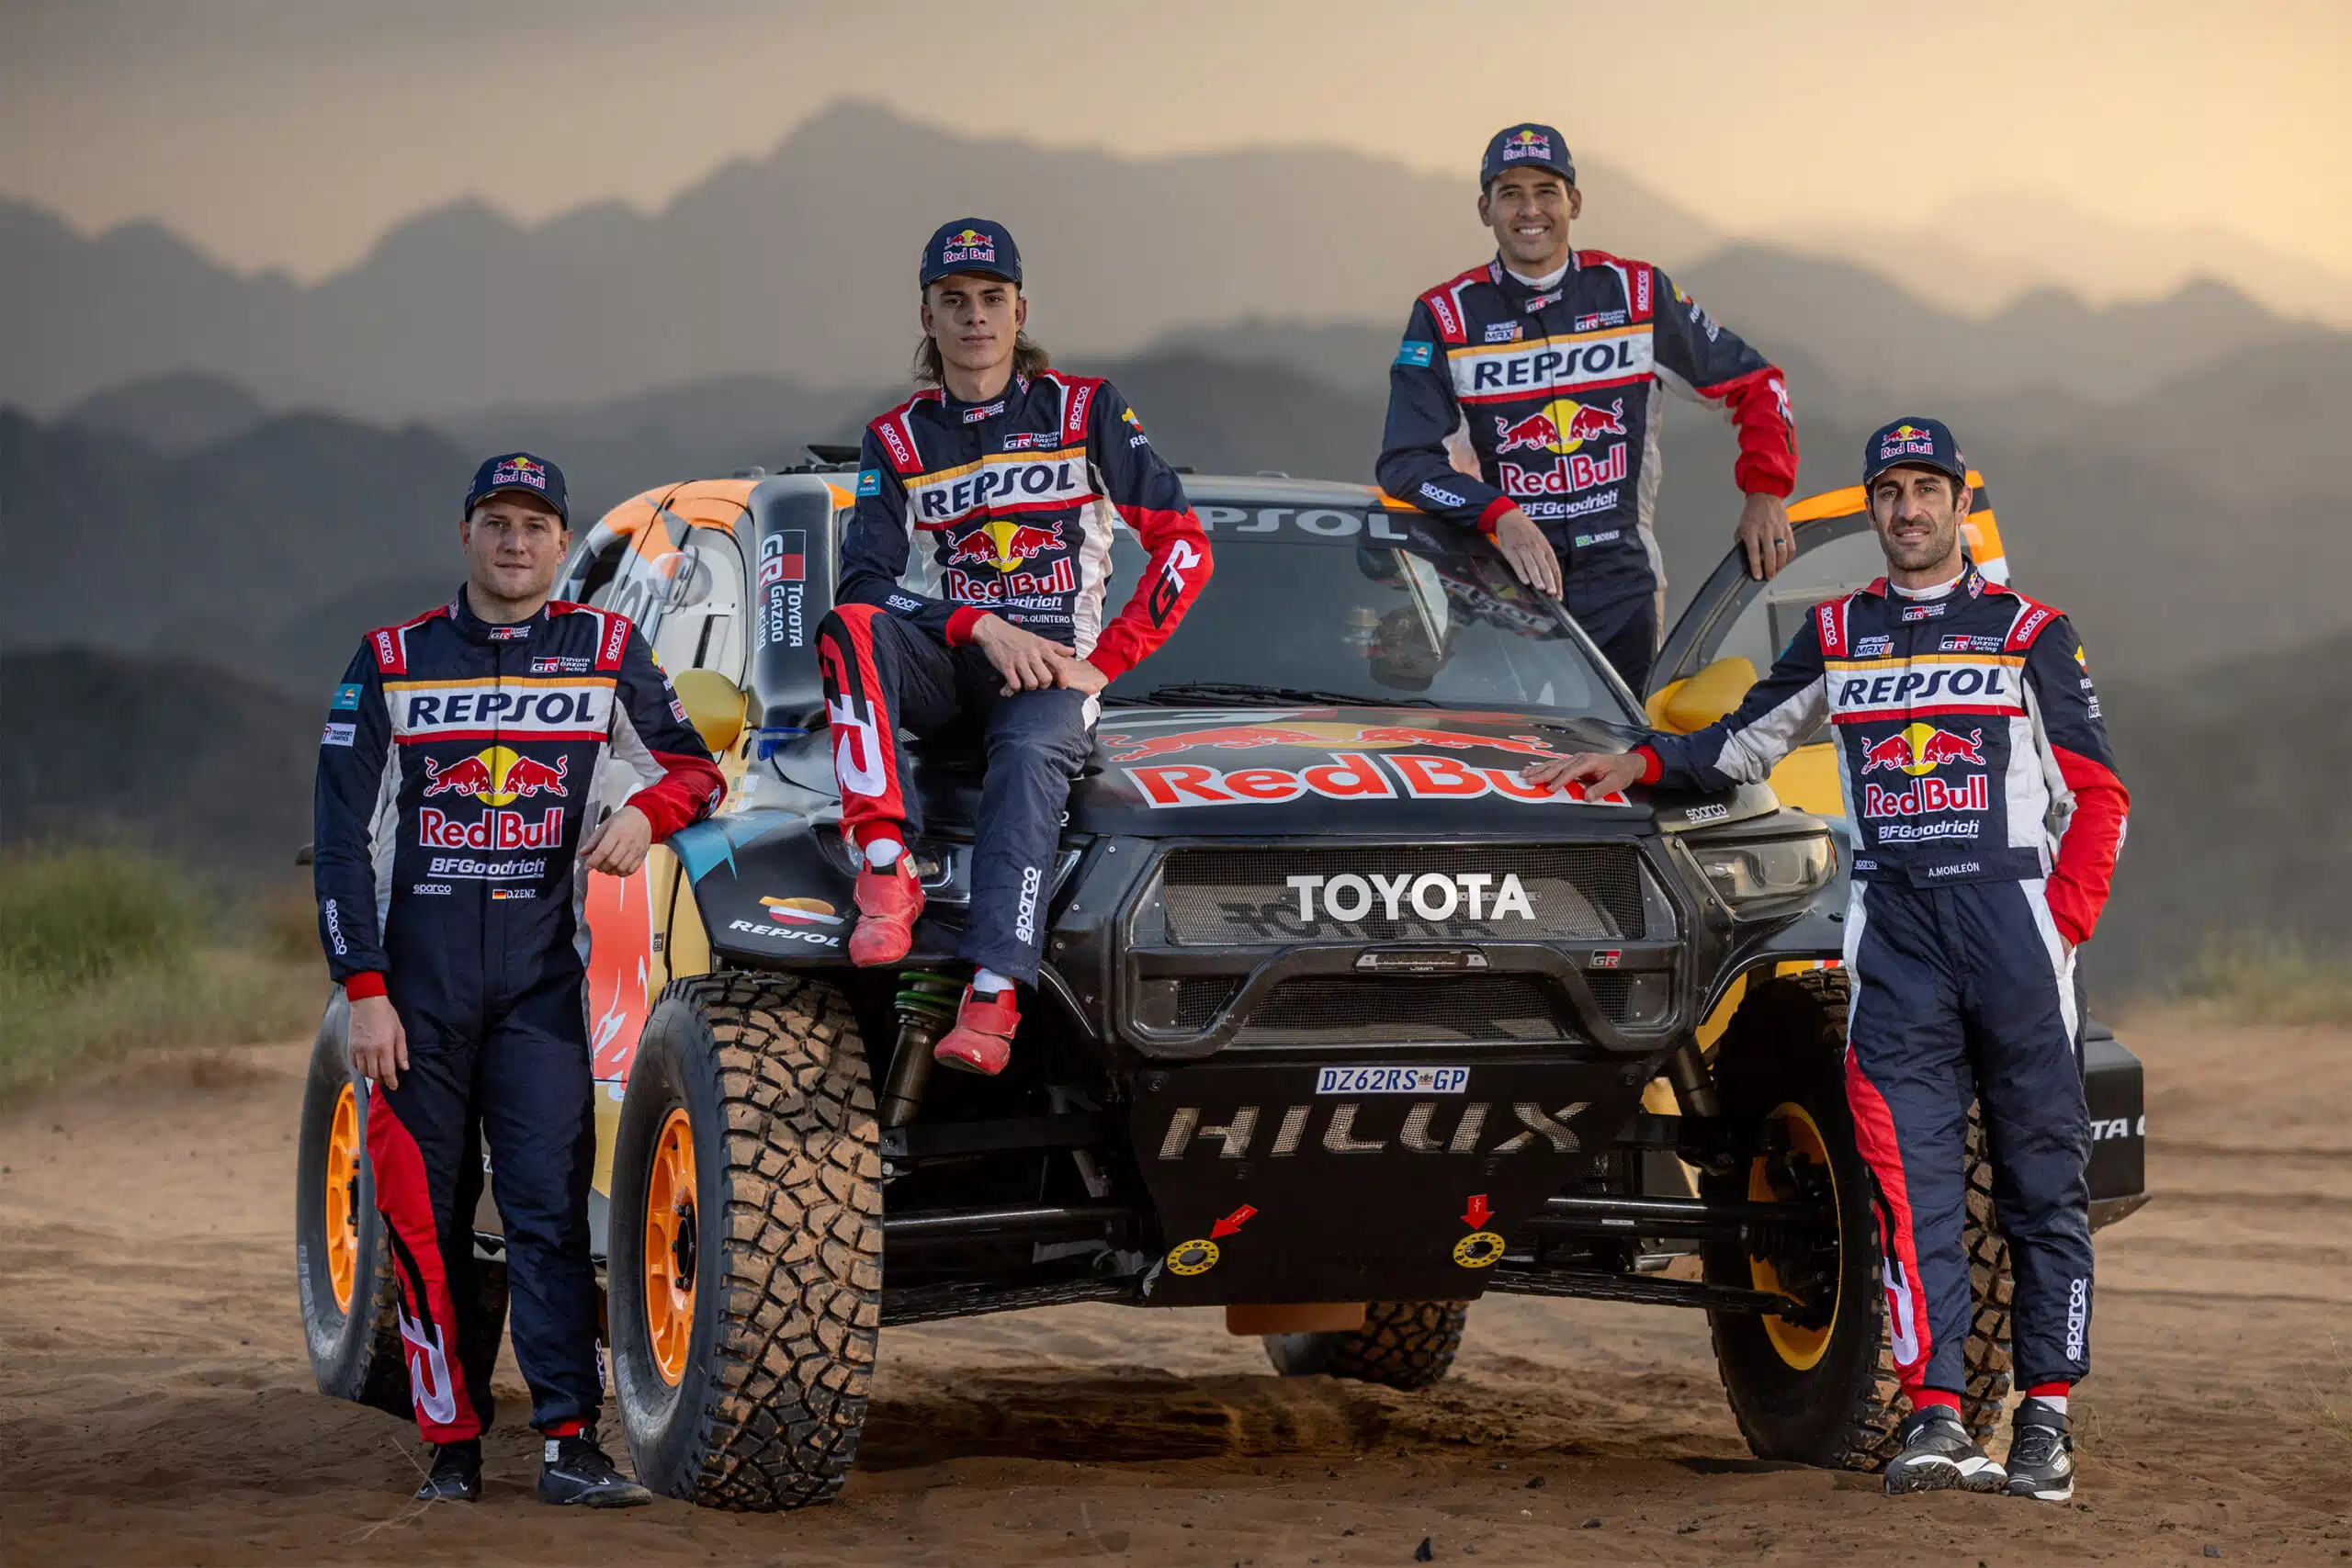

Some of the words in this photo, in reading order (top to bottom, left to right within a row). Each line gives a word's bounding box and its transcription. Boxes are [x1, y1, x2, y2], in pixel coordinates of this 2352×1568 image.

[1503, 146, 1527, 162] Red
[1527, 145, 1551, 161] Bull
[943, 247, 967, 264] Red
[969, 247, 995, 263] Bull
[1637, 270, 1650, 312] sparco
[1430, 296, 1457, 334] sparco
[1474, 340, 1634, 391] REPSOL
[1069, 386, 1091, 431] sparco
[879, 423, 910, 465] sparco
[1034, 431, 1060, 439] TOYOTA
[1881, 442, 1905, 460] Red
[1907, 441, 1933, 455] Bull
[492, 471, 518, 485] Red
[520, 471, 546, 489] Bull
[1498, 456, 1572, 496] Red
[1569, 442, 1627, 491] Bull
[922, 462, 1076, 517] REPSOL
[1419, 481, 1466, 508] sparco
[1194, 506, 1408, 541] PSOL
[760, 533, 784, 591] GR
[946, 568, 1011, 602] Red
[1011, 557, 1076, 597] Bull
[1148, 538, 1203, 630] GR
[770, 585, 786, 643] GAZOO
[787, 583, 804, 648] TOYOTA
[886, 594, 922, 612] spar
[1023, 614, 1070, 624] S.QUINTERO
[606, 619, 628, 661] sparco
[1820, 606, 1838, 647] sparco
[1859, 635, 1890, 645] SPEED
[2017, 609, 2049, 643] sparco
[376, 631, 395, 665] sparco
[1856, 644, 1884, 657] MAX
[1838, 668, 2005, 706] REPSOL
[407, 692, 596, 728] REPSOL
[1122, 751, 1397, 809] Red
[1379, 754, 1632, 807] Bu
[1863, 777, 1923, 818] Red
[1922, 774, 1989, 813] Bull
[419, 807, 495, 850] Red
[497, 807, 564, 850] Bull
[1685, 803, 1730, 825] sparco
[1878, 820, 1980, 840] BFGoodrich
[429, 857, 547, 875] BFGoodrich
[1854, 860, 1878, 870] sparco
[1928, 862, 1980, 878] A.MONLEÓN
[413, 883, 452, 896] sparco
[506, 888, 537, 899] D.ZENZ
[1015, 865, 1042, 945] sparco
[1286, 873, 1537, 922] TOYOTA
[325, 898, 347, 955] sparco
[729, 919, 840, 948] REPSOL
[1321, 1069, 1419, 1092] DZ62RS
[1432, 1068, 1466, 1091] GP
[1159, 1102, 1594, 1158] HILUX
[2067, 1278, 2086, 1360] sparco
